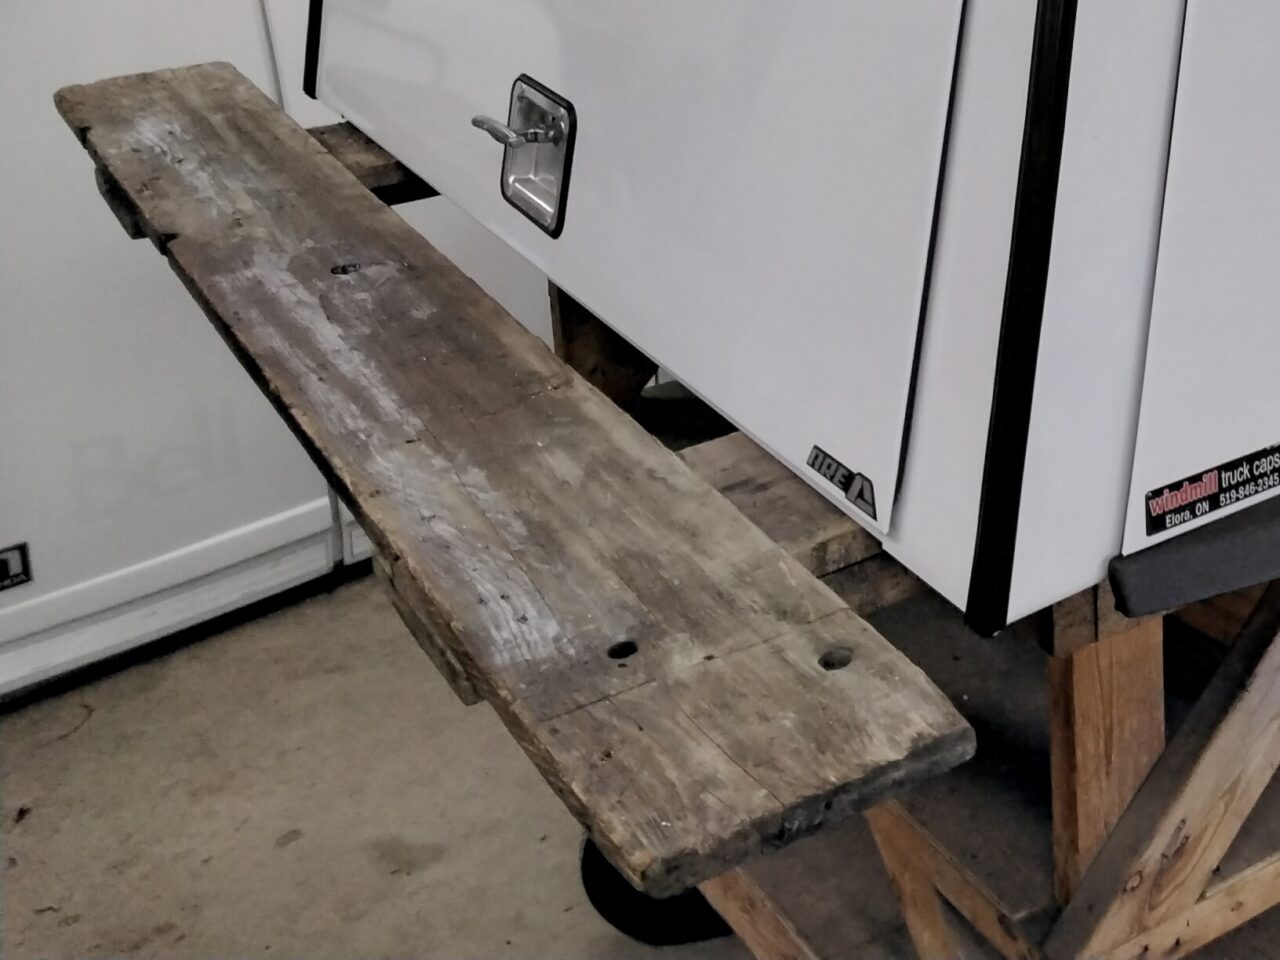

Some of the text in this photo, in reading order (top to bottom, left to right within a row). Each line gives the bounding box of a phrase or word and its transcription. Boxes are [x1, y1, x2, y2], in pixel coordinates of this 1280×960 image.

[1148, 469, 1219, 517] windmill
[1221, 462, 1250, 488] truck
[1165, 473, 1280, 528] Elora, ON 519-846-2345
